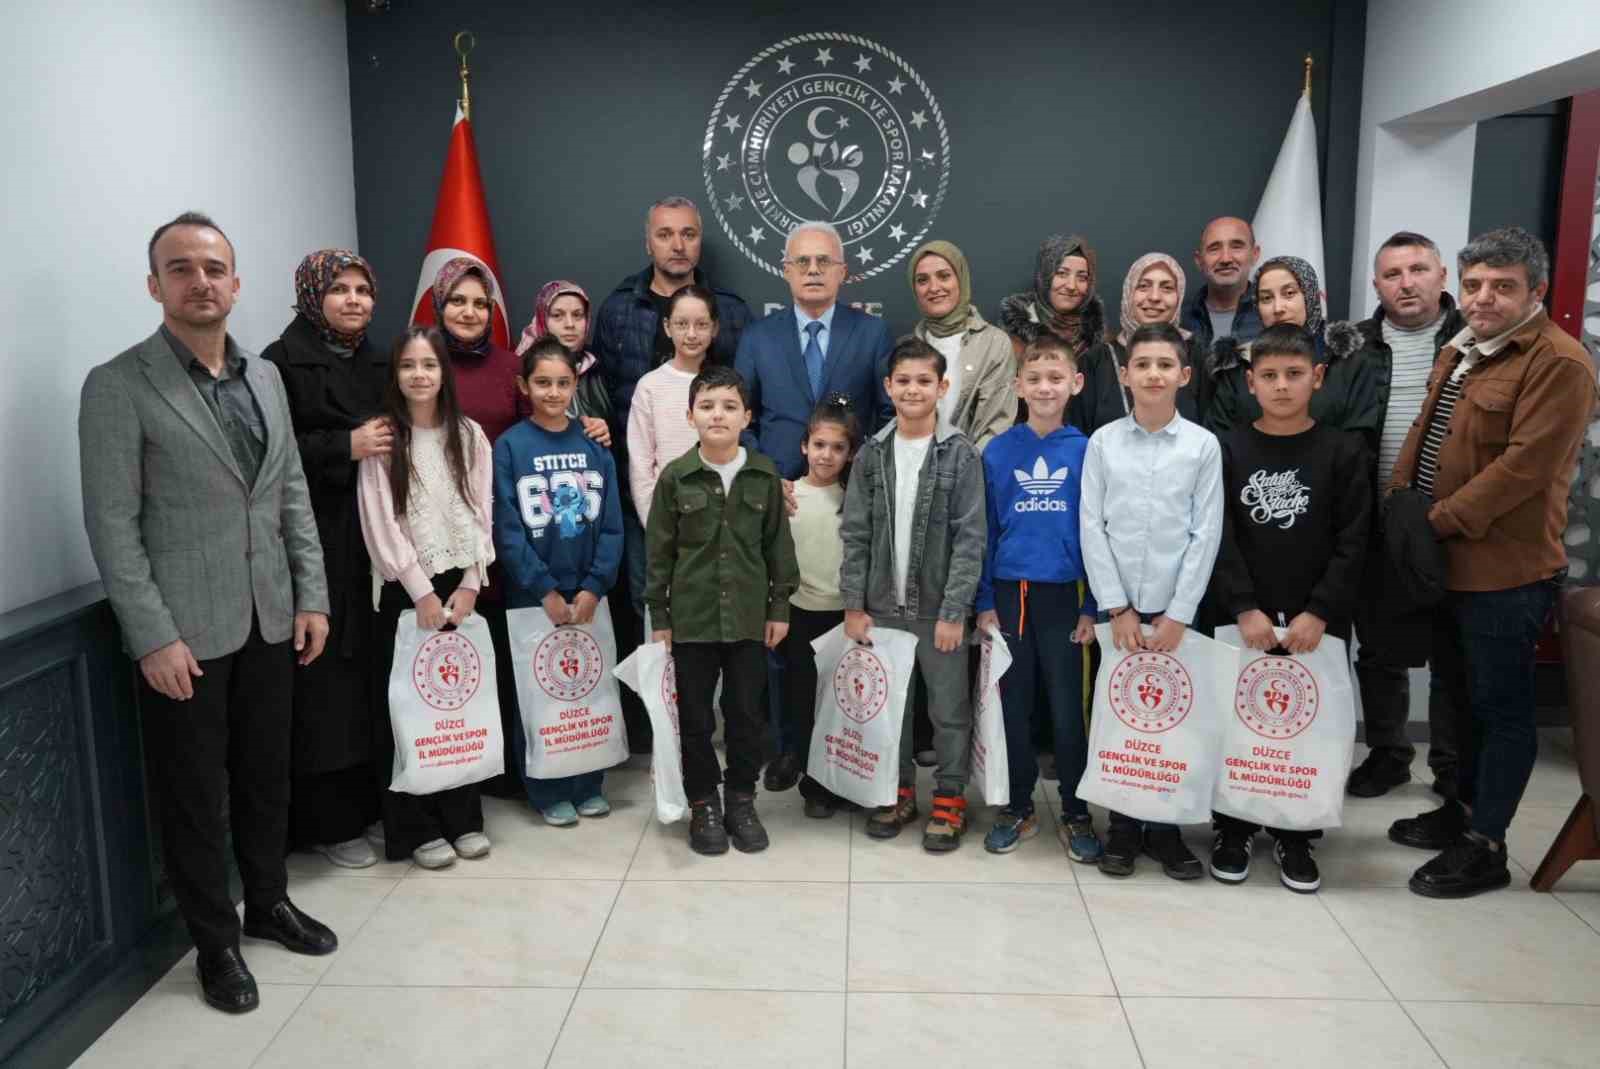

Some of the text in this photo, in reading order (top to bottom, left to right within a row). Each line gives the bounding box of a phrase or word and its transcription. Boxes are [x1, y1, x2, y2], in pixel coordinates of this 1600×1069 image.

[748, 85, 800, 186] CUMHURİYETİ
[802, 80, 870, 103] GENÇLİK
[869, 98, 888, 119] VE
[883, 119, 904, 161] SPOR
[533, 453, 588, 472] STITCH
[1014, 497, 1067, 512] adidas
[560, 707, 590, 720] DÜZCE
[578, 720, 588, 728] VE
[591, 714, 613, 725] SPOR
[415, 728, 487, 747] GENÇLİK VE SPOR
[1125, 738, 1162, 754] DÜZCE
[1098, 751, 1187, 772] GENÇLİK VE SPOR
[1252, 745, 1291, 760] DÜZCE
[1102, 763, 1180, 784] İL MÜDÜRLÜĞÜ
[1225, 757, 1317, 776] GENÇLİK VE SPOR
[1229, 769, 1311, 789] İL MÜDÜRLÜĞÜ
